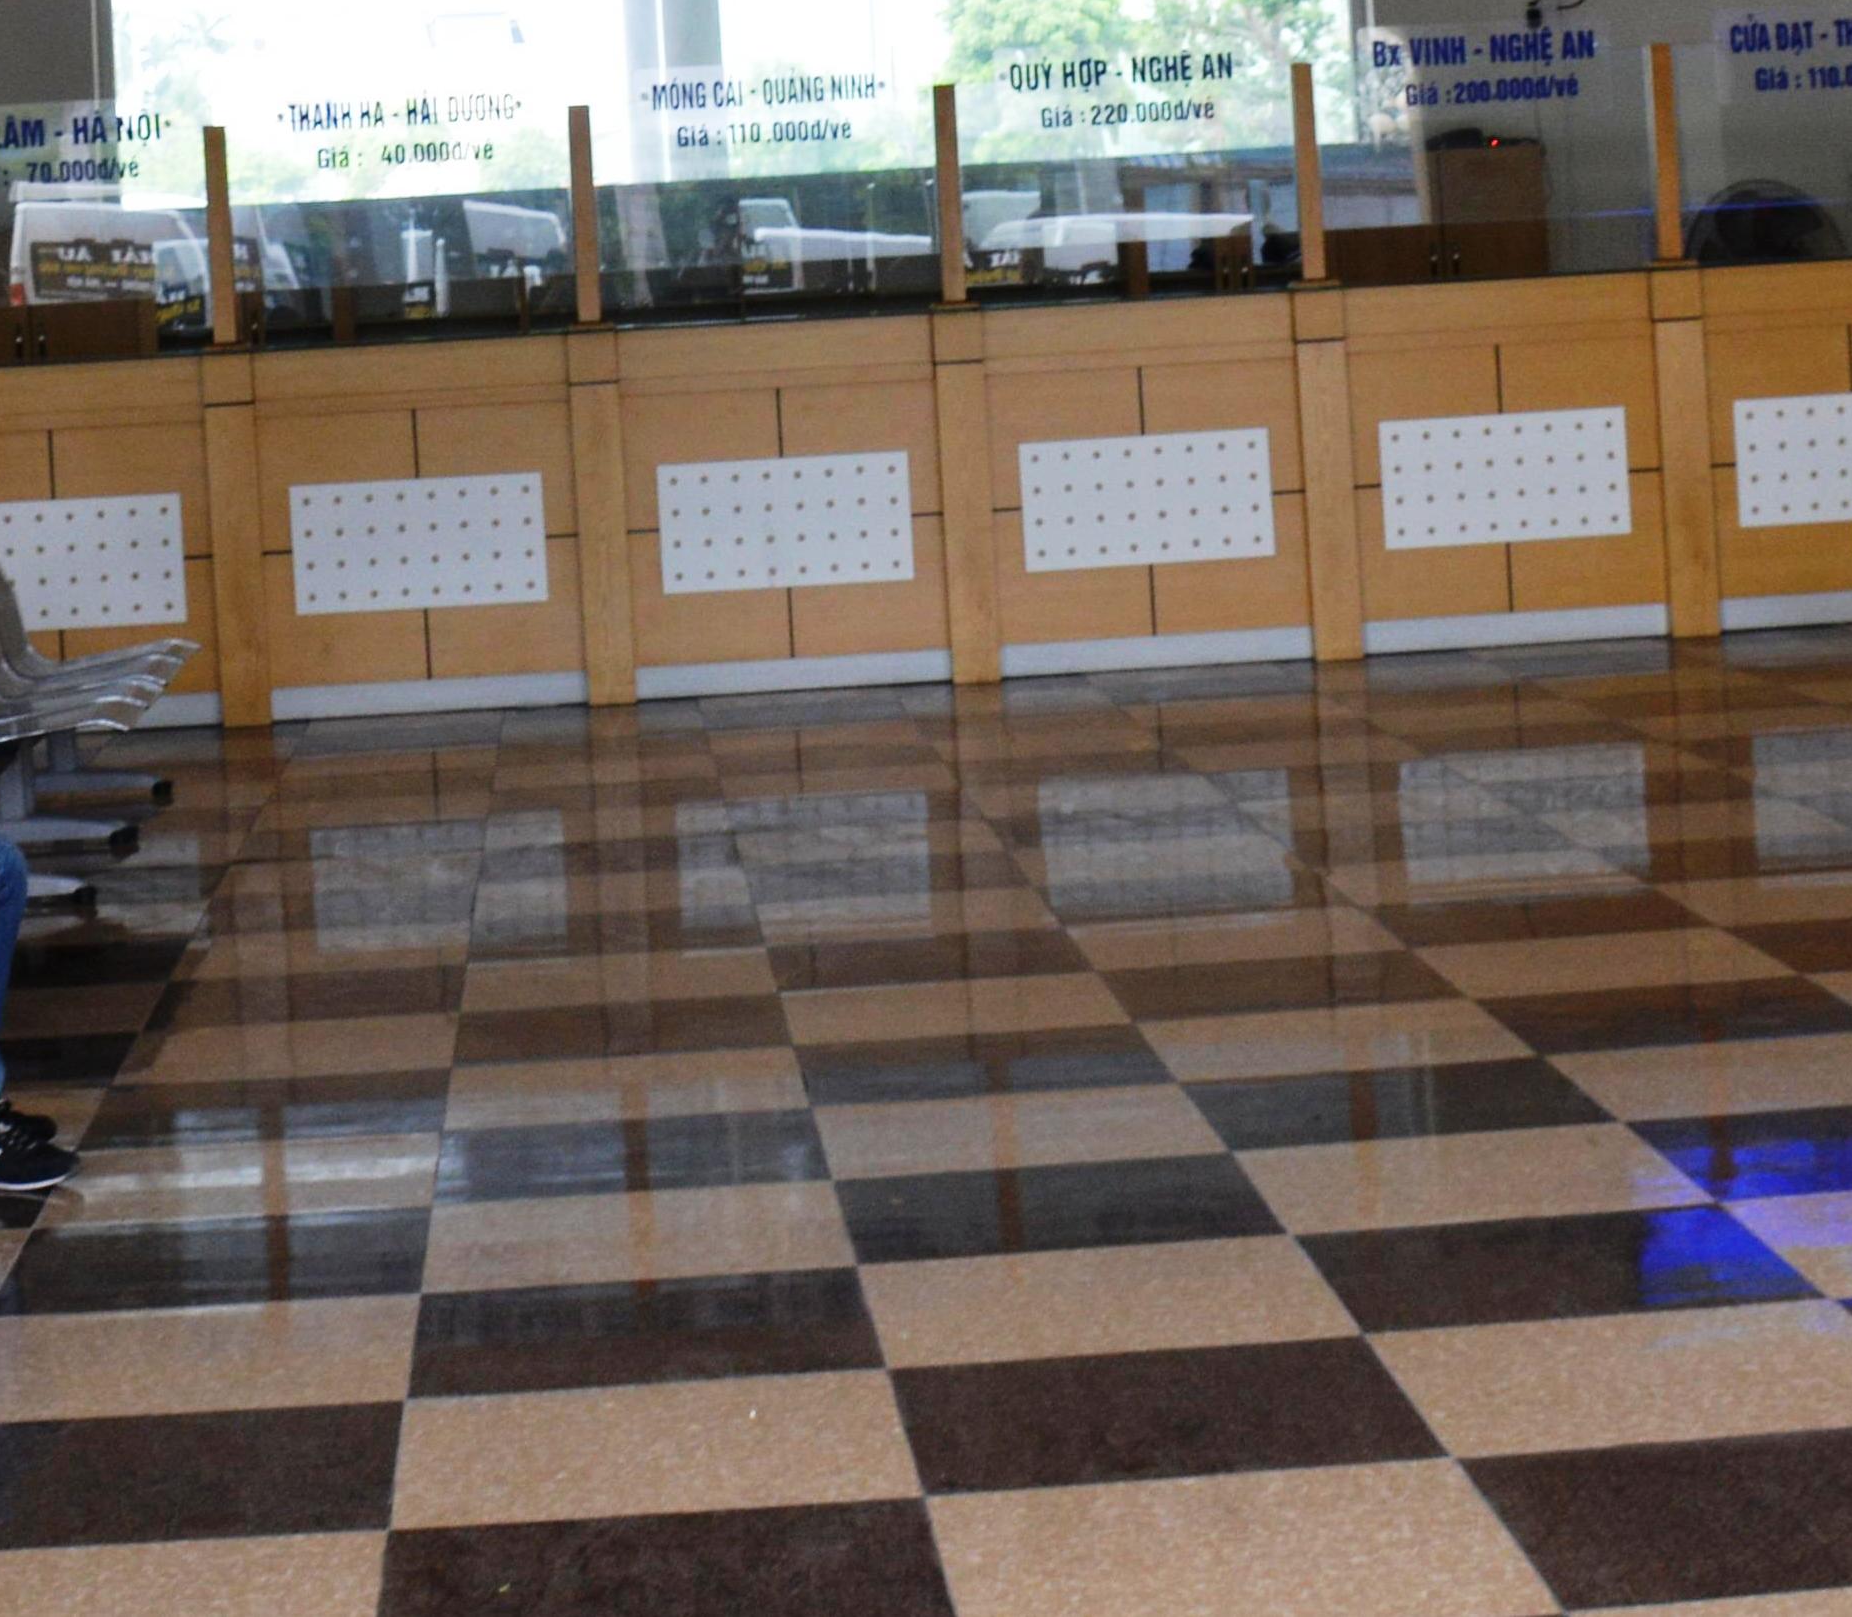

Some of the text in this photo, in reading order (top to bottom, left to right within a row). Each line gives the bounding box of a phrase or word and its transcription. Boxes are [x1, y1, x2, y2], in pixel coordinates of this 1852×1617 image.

[1372, 40, 1401, 67] Bx
[1409, 36, 1466, 66] VINH
[1490, 28, 1554, 67] NGHỆ
[1561, 30, 1595, 59] AN
[830, 73, 876, 101] NINH
[1063, 57, 1107, 92] HỢP
[1132, 50, 1192, 87] NGHỆ
[1202, 53, 1233, 80] AN
[288, 100, 352, 132] THANH
